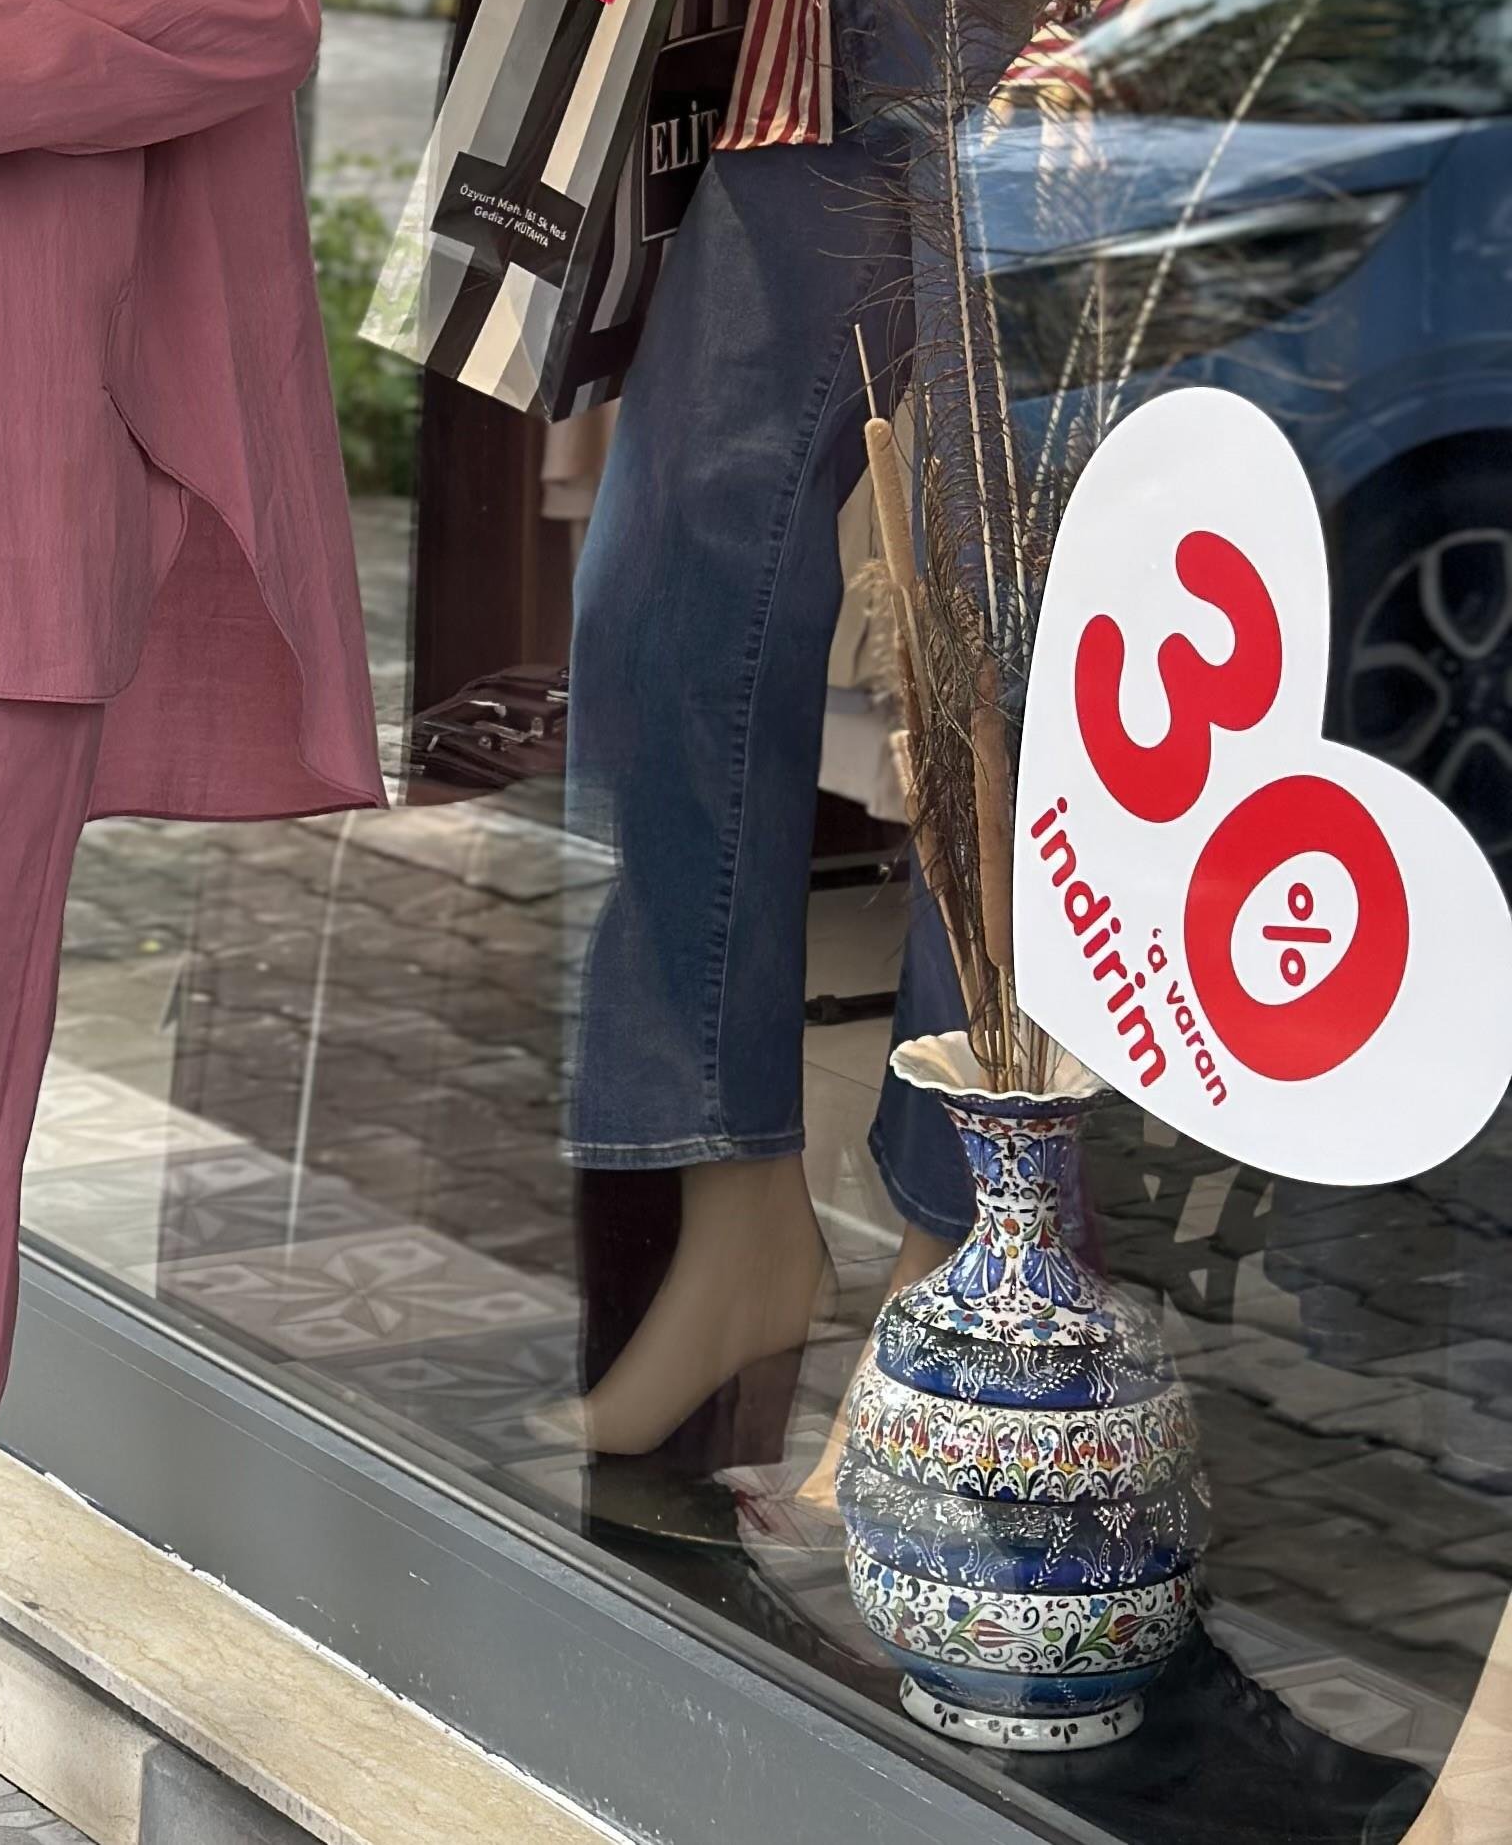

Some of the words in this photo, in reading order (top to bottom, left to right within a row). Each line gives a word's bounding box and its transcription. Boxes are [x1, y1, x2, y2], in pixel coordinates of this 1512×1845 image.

[473, 205, 505, 225] Gediz
[514, 220, 549, 248] KÜTAHYA
[497, 198, 523, 217] Mah.
[1074, 530, 1409, 1082] 30
[1031, 796, 1167, 1088] indirim
[1165, 980, 1228, 1107] varan
